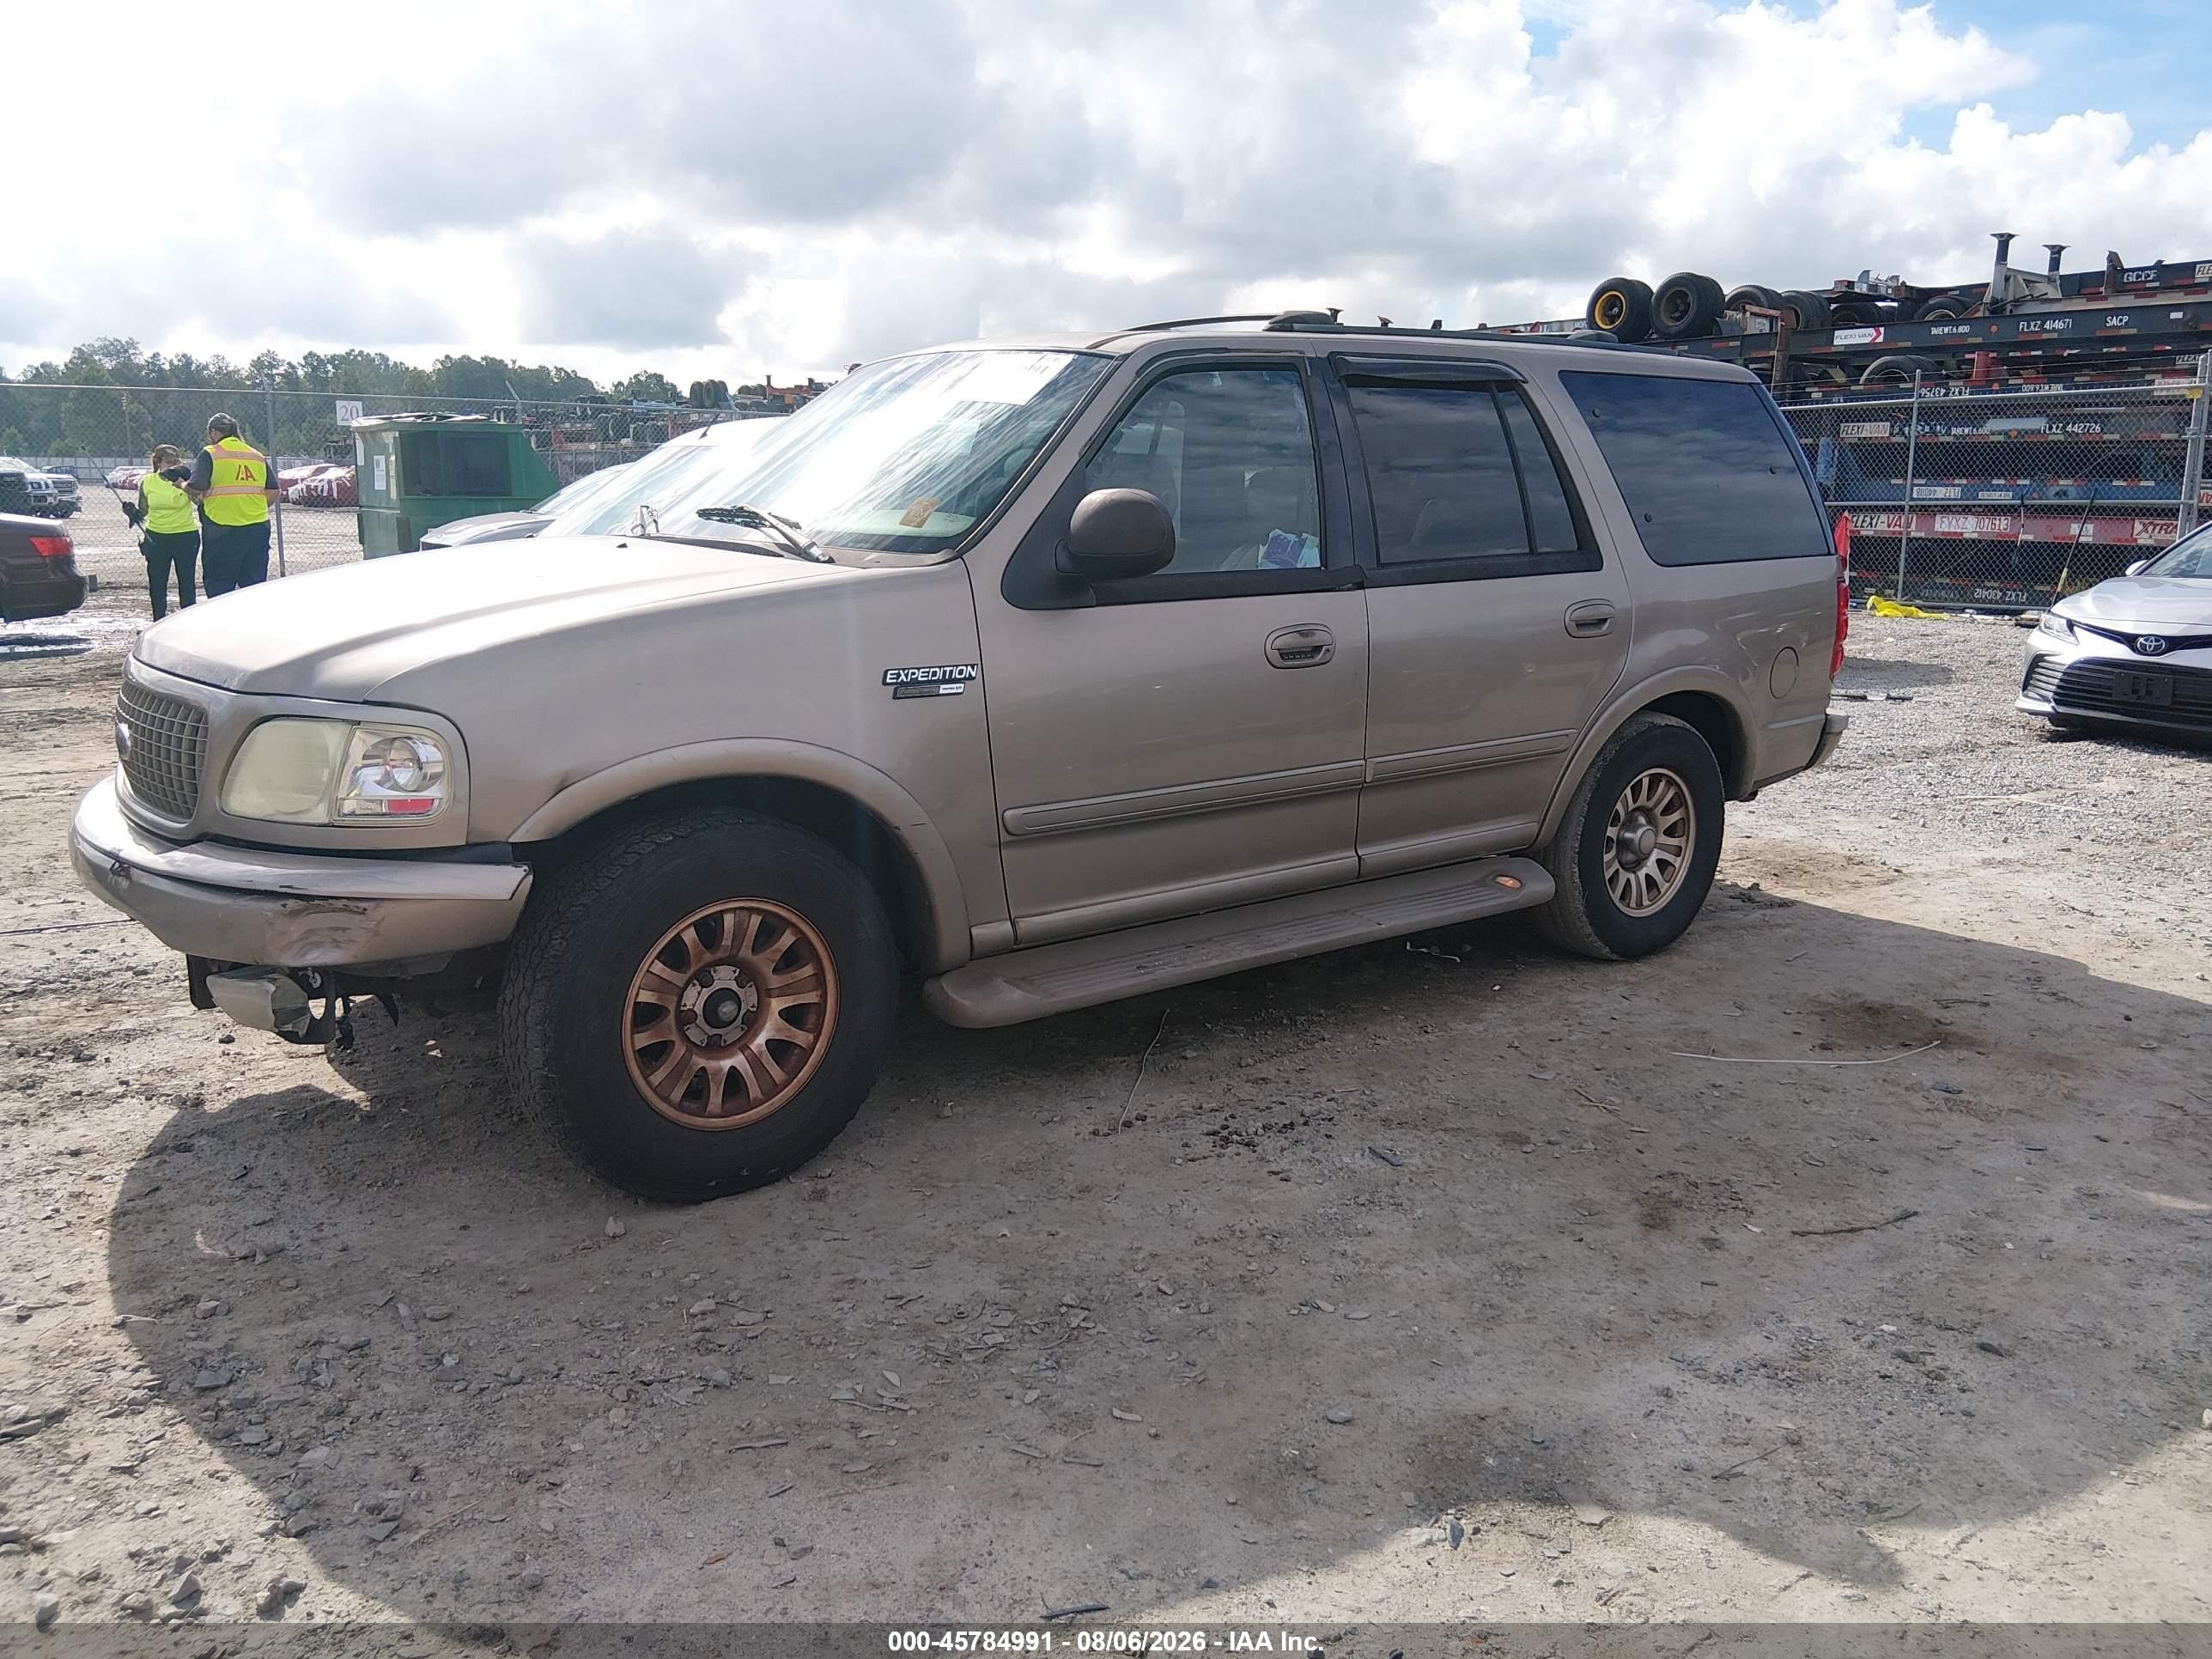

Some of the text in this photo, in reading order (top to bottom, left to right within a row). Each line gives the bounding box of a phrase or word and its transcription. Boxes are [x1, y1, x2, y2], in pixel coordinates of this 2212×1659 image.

[2019, 318, 2073, 332] FLXZ 414671
[2106, 315, 2129, 327] SACP
[1948, 386, 1970, 397] FLXZ
[339, 404, 360, 422] 20
[2040, 422, 2102, 434] FLXZ 442726
[1973, 516, 2010, 532] 707613
[1972, 587, 2027, 602] FLXZ 430412
[885, 665, 978, 684] EXPEDITION
